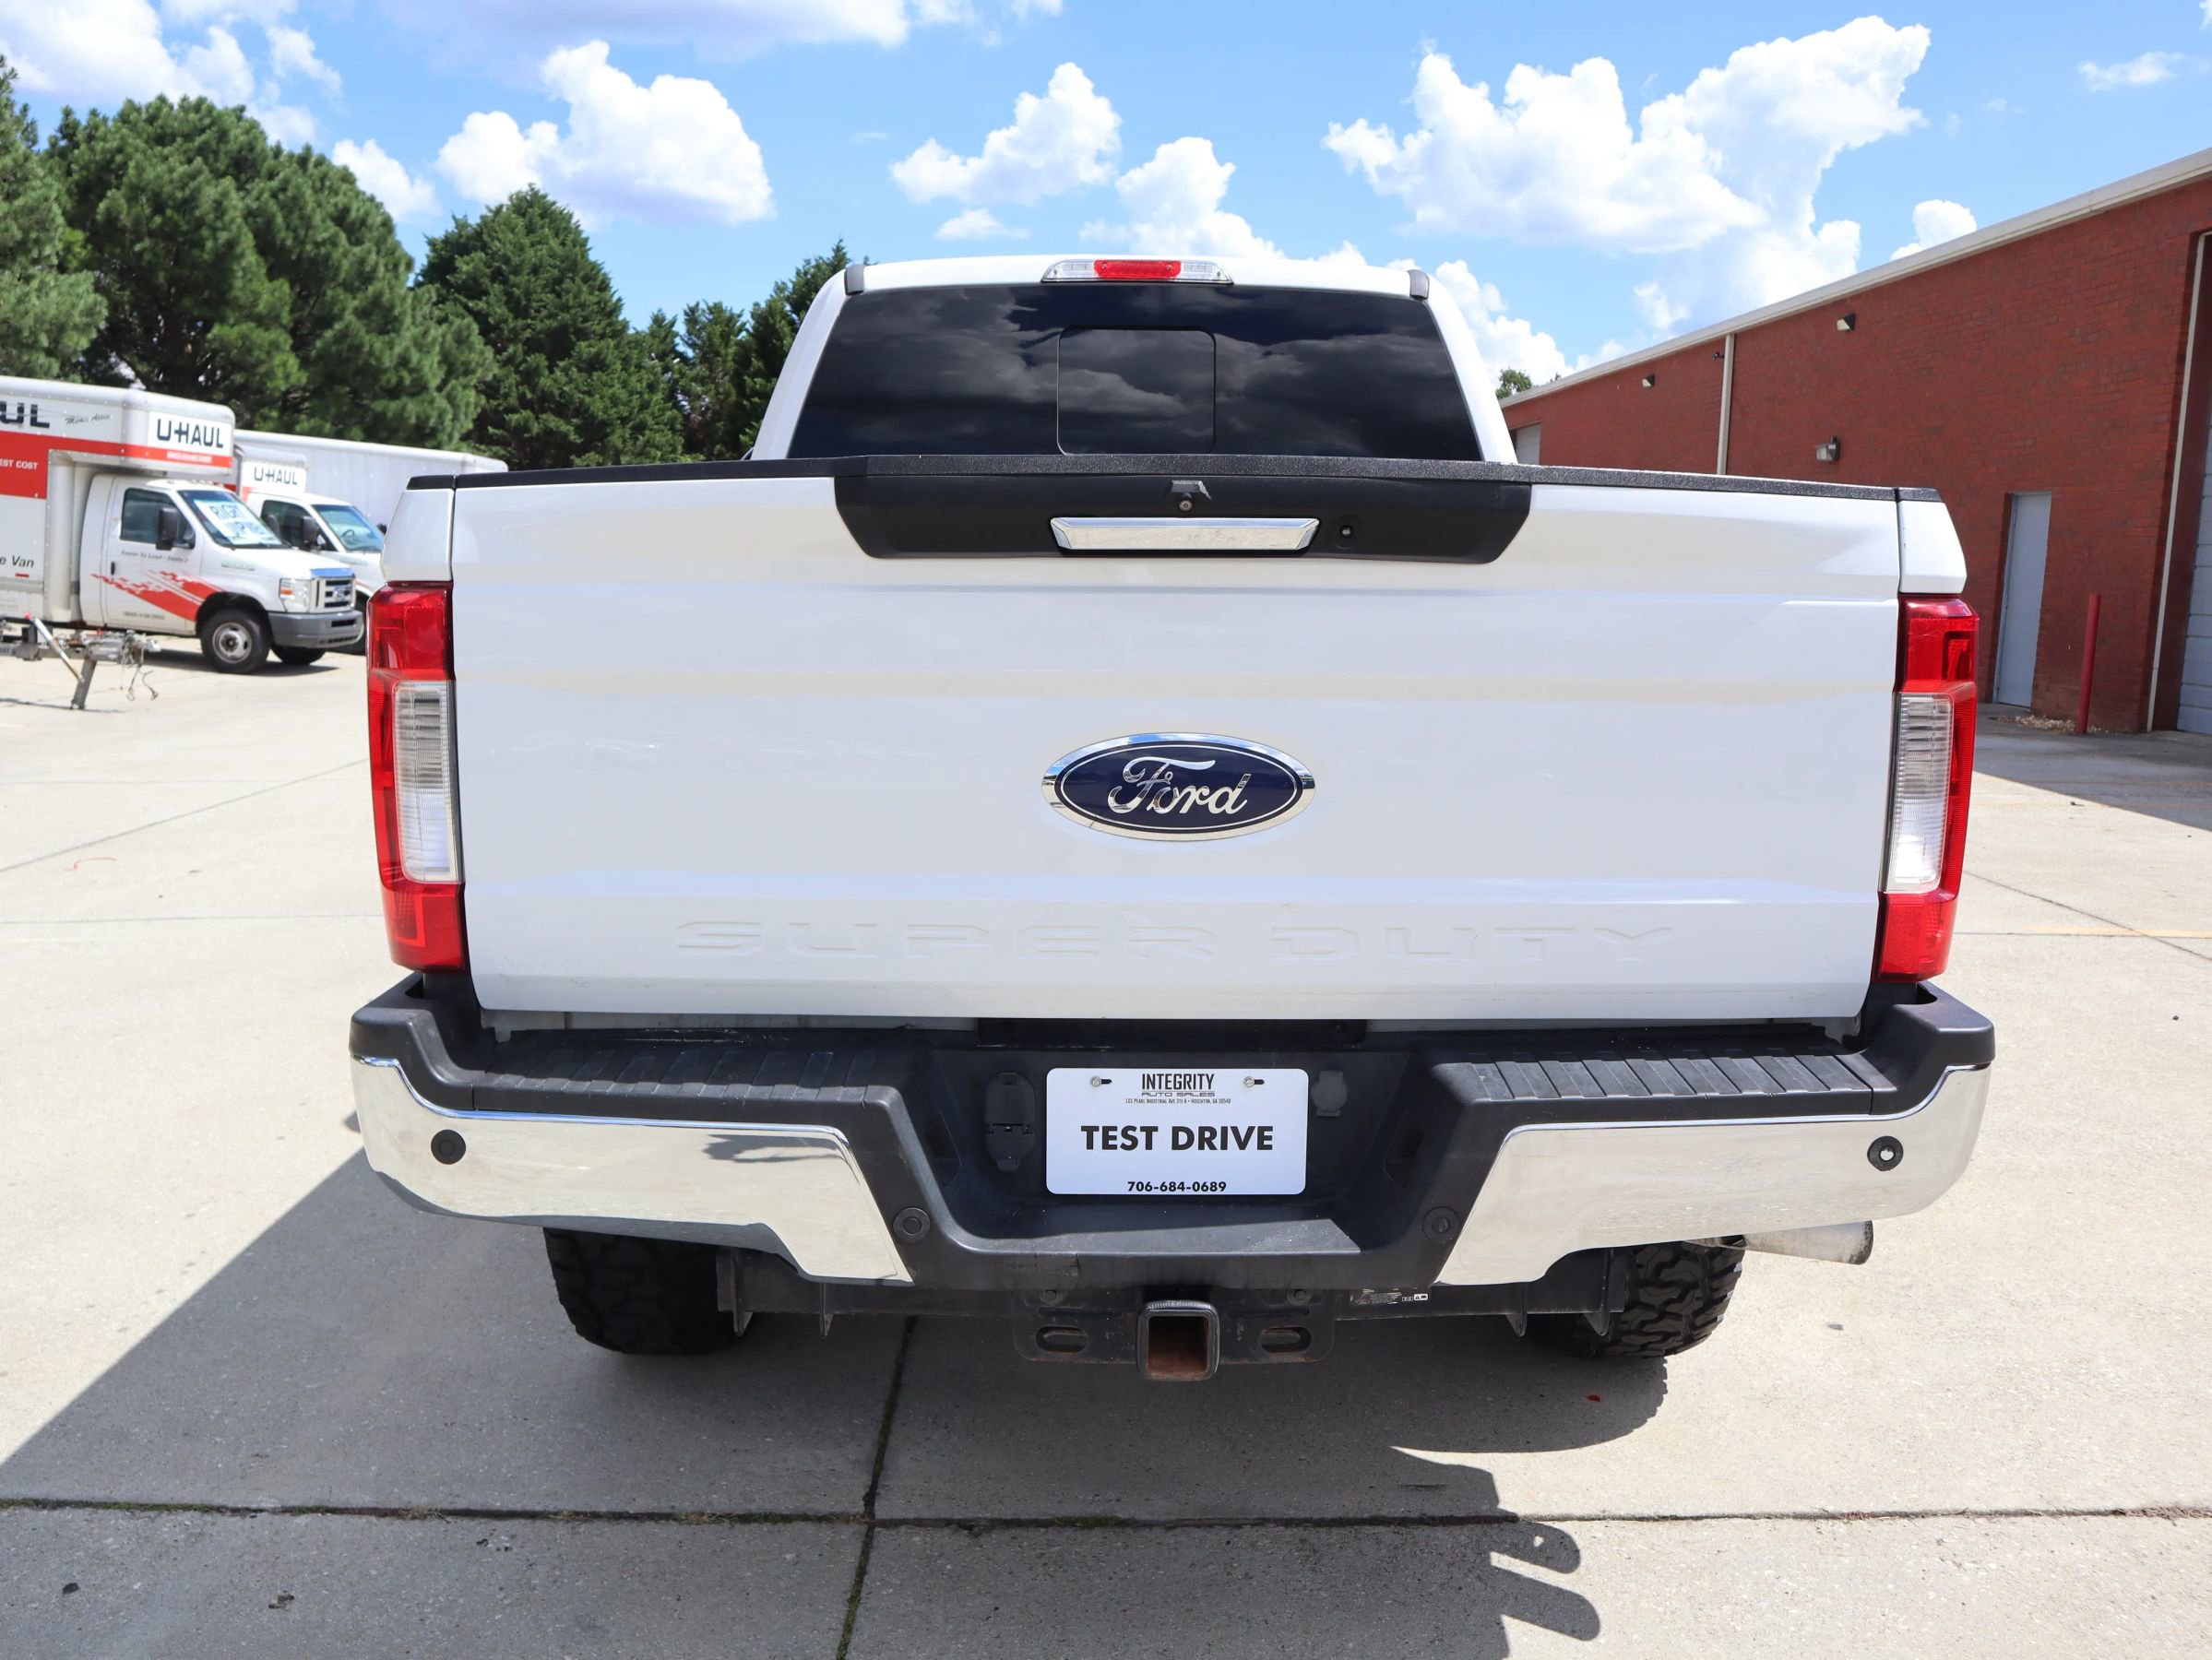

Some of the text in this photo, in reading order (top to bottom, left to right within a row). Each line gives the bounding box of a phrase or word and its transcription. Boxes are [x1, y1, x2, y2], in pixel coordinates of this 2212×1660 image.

[16, 459, 38, 470] COST
[12, 554, 34, 568] Van
[1107, 756, 1251, 814] Ford
[676, 920, 1673, 962] SUPER DUTY
[1142, 1073, 1215, 1090] INTEGRITY
[1080, 1125, 1274, 1151] TEST DRIVE
[1127, 1181, 1227, 1192] 706-684-0689
